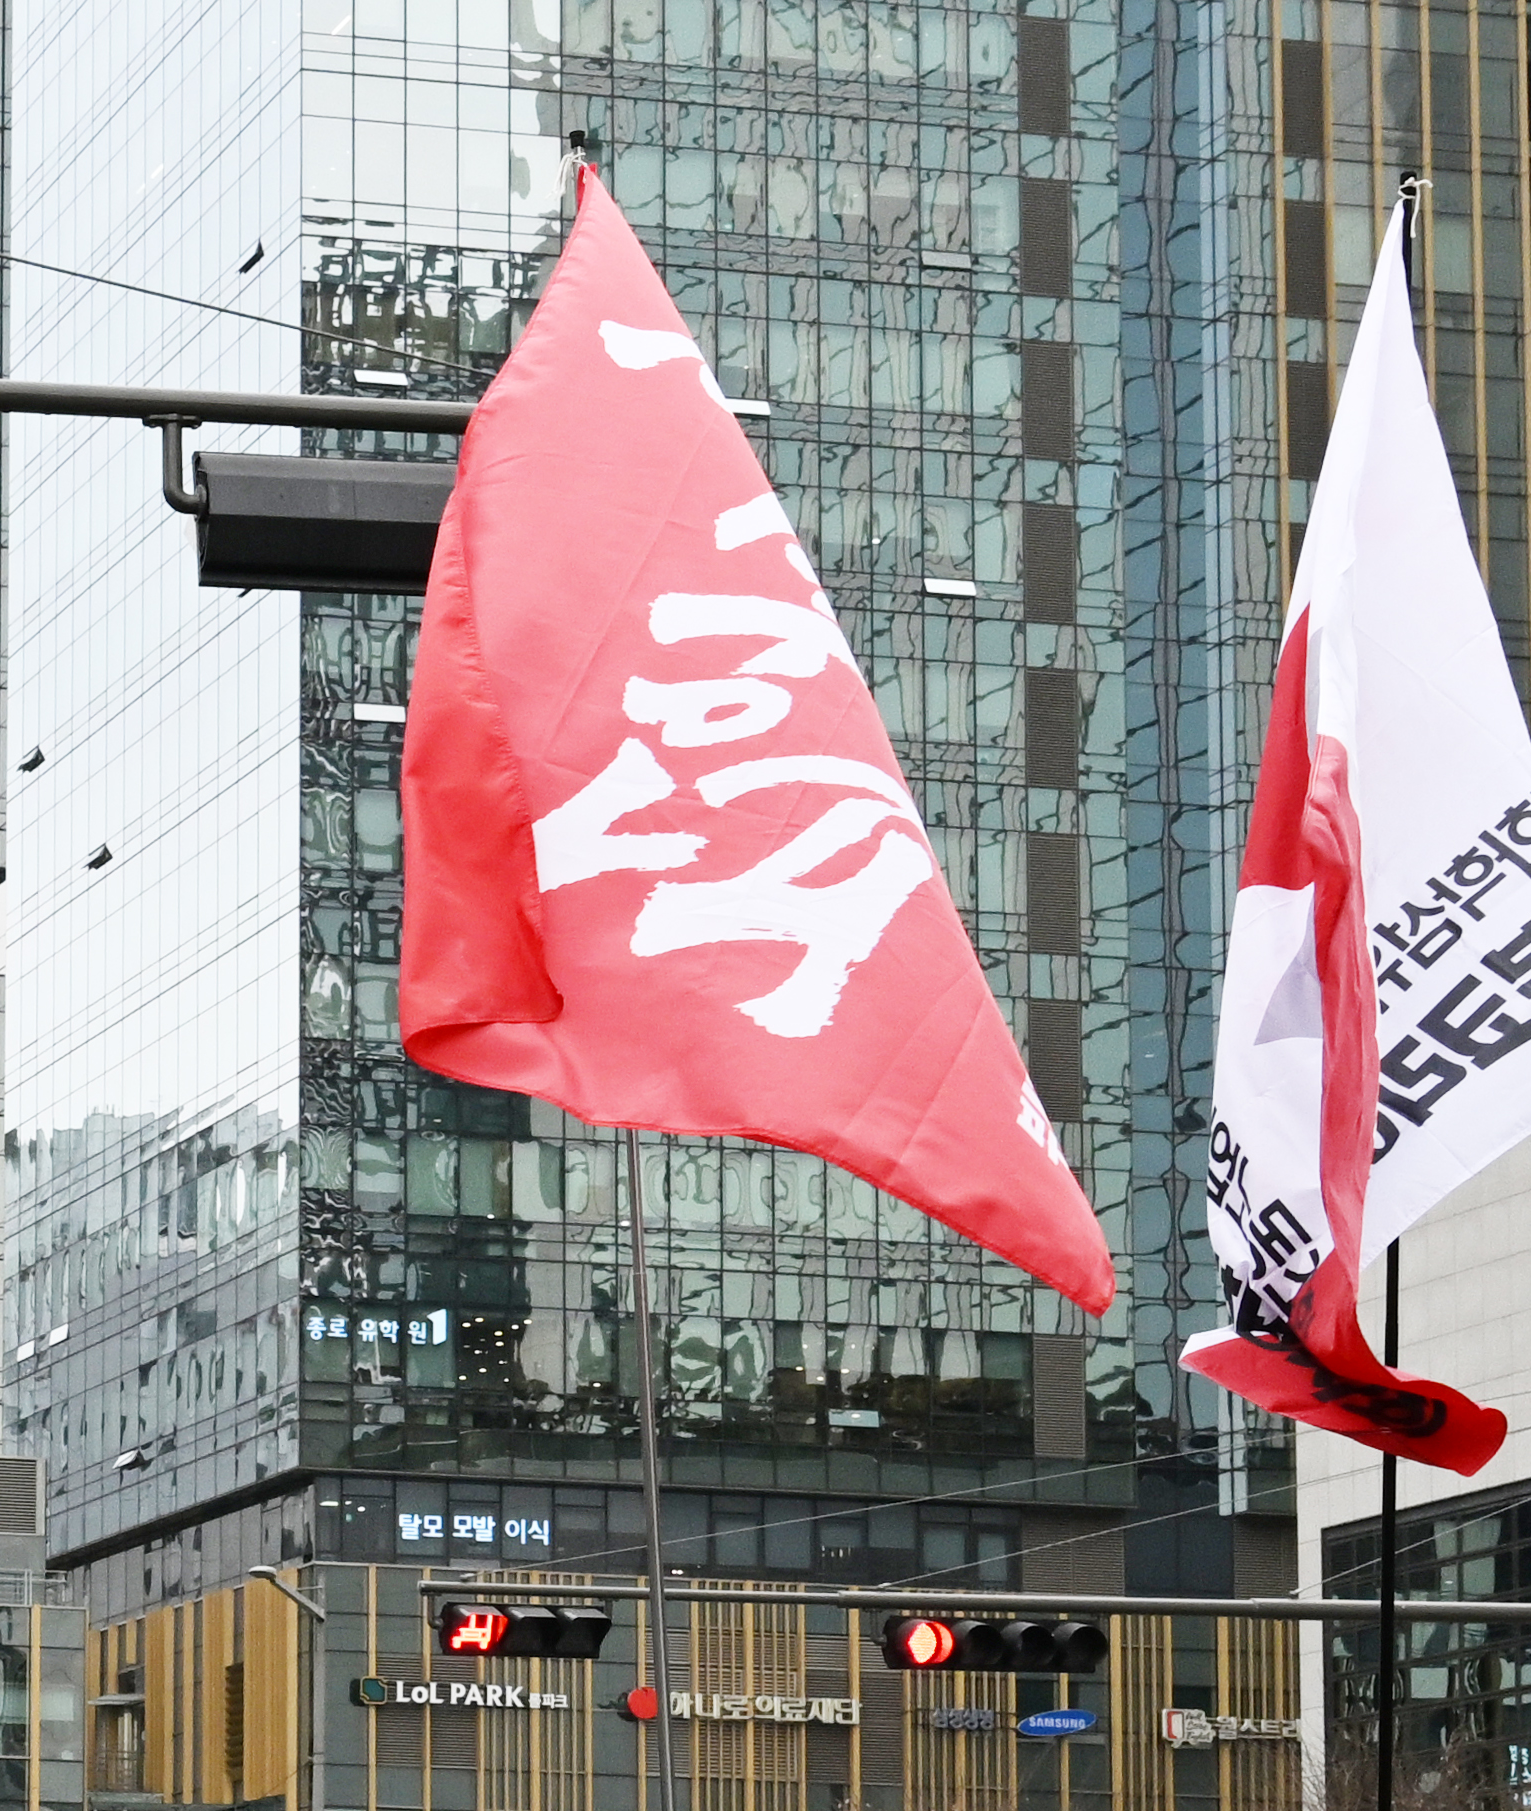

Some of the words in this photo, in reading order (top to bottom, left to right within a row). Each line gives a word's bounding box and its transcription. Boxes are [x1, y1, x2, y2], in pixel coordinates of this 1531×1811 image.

[306, 1317, 348, 1341] 종로
[398, 1513, 444, 1540] 탈모
[452, 1515, 496, 1543] 모발
[504, 1519, 551, 1546] 이식
[395, 1681, 437, 1704] LoL
[450, 1683, 524, 1708] PARK
[528, 1692, 568, 1709] 롤파크
[1028, 1714, 1087, 1731] SAMSUNG
